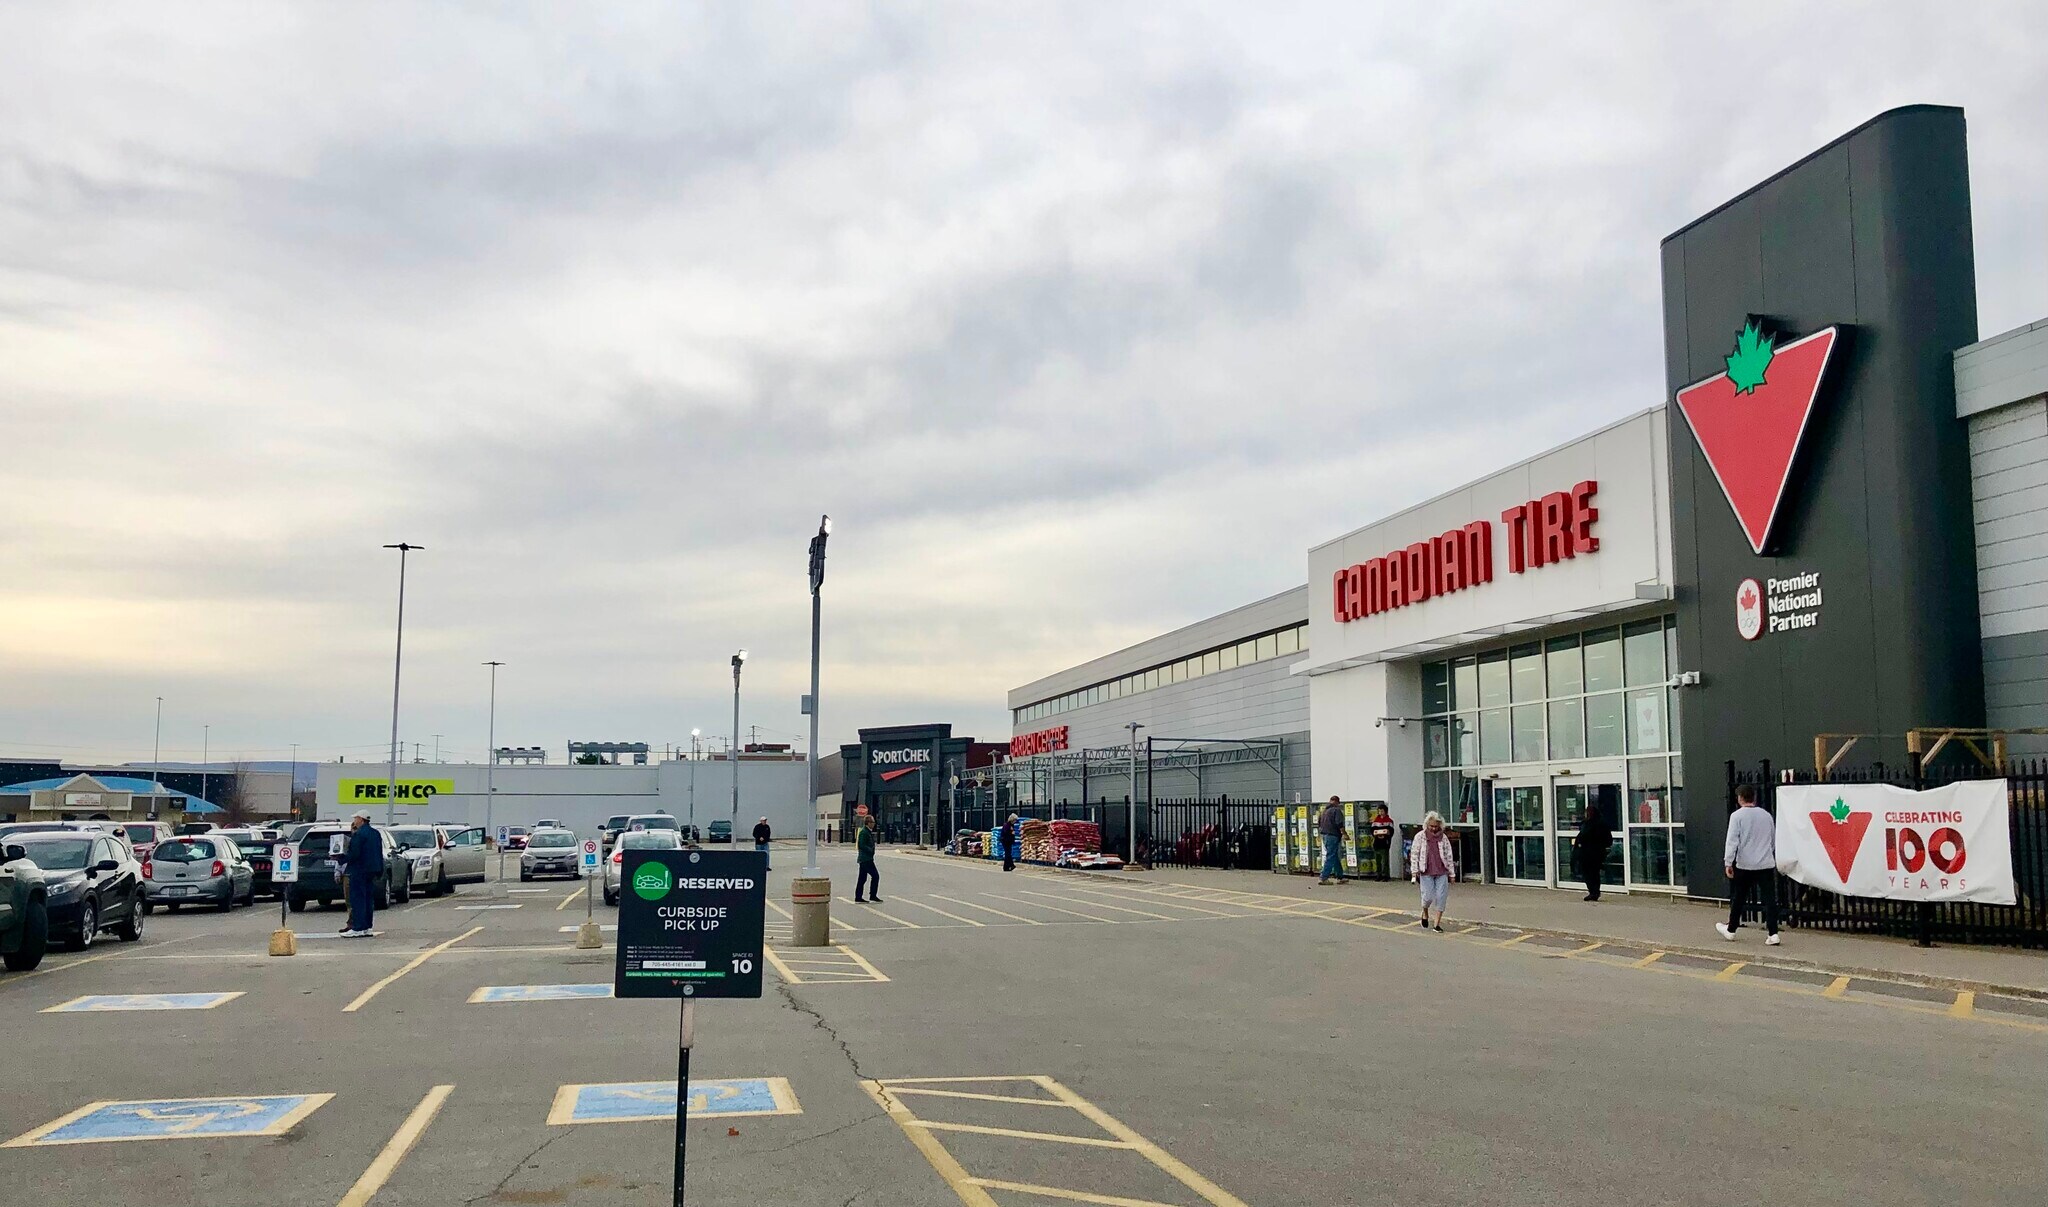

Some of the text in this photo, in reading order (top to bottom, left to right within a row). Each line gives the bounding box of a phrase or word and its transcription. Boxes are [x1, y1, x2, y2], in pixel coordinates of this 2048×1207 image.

[1333, 480, 1600, 623] CANADIAN TIRE
[1767, 571, 1820, 596] Premier
[1768, 587, 1823, 615] National
[1769, 612, 1819, 633] Partner
[1011, 732, 1038, 757] GARDEN
[1885, 811, 1963, 824] CELEBRATING
[1885, 827, 1967, 874] 100
[678, 878, 755, 890] RESERVED
[657, 907, 727, 918] CURBSIDE
[664, 920, 720, 931] PICK UP
[731, 959, 753, 974] 10
